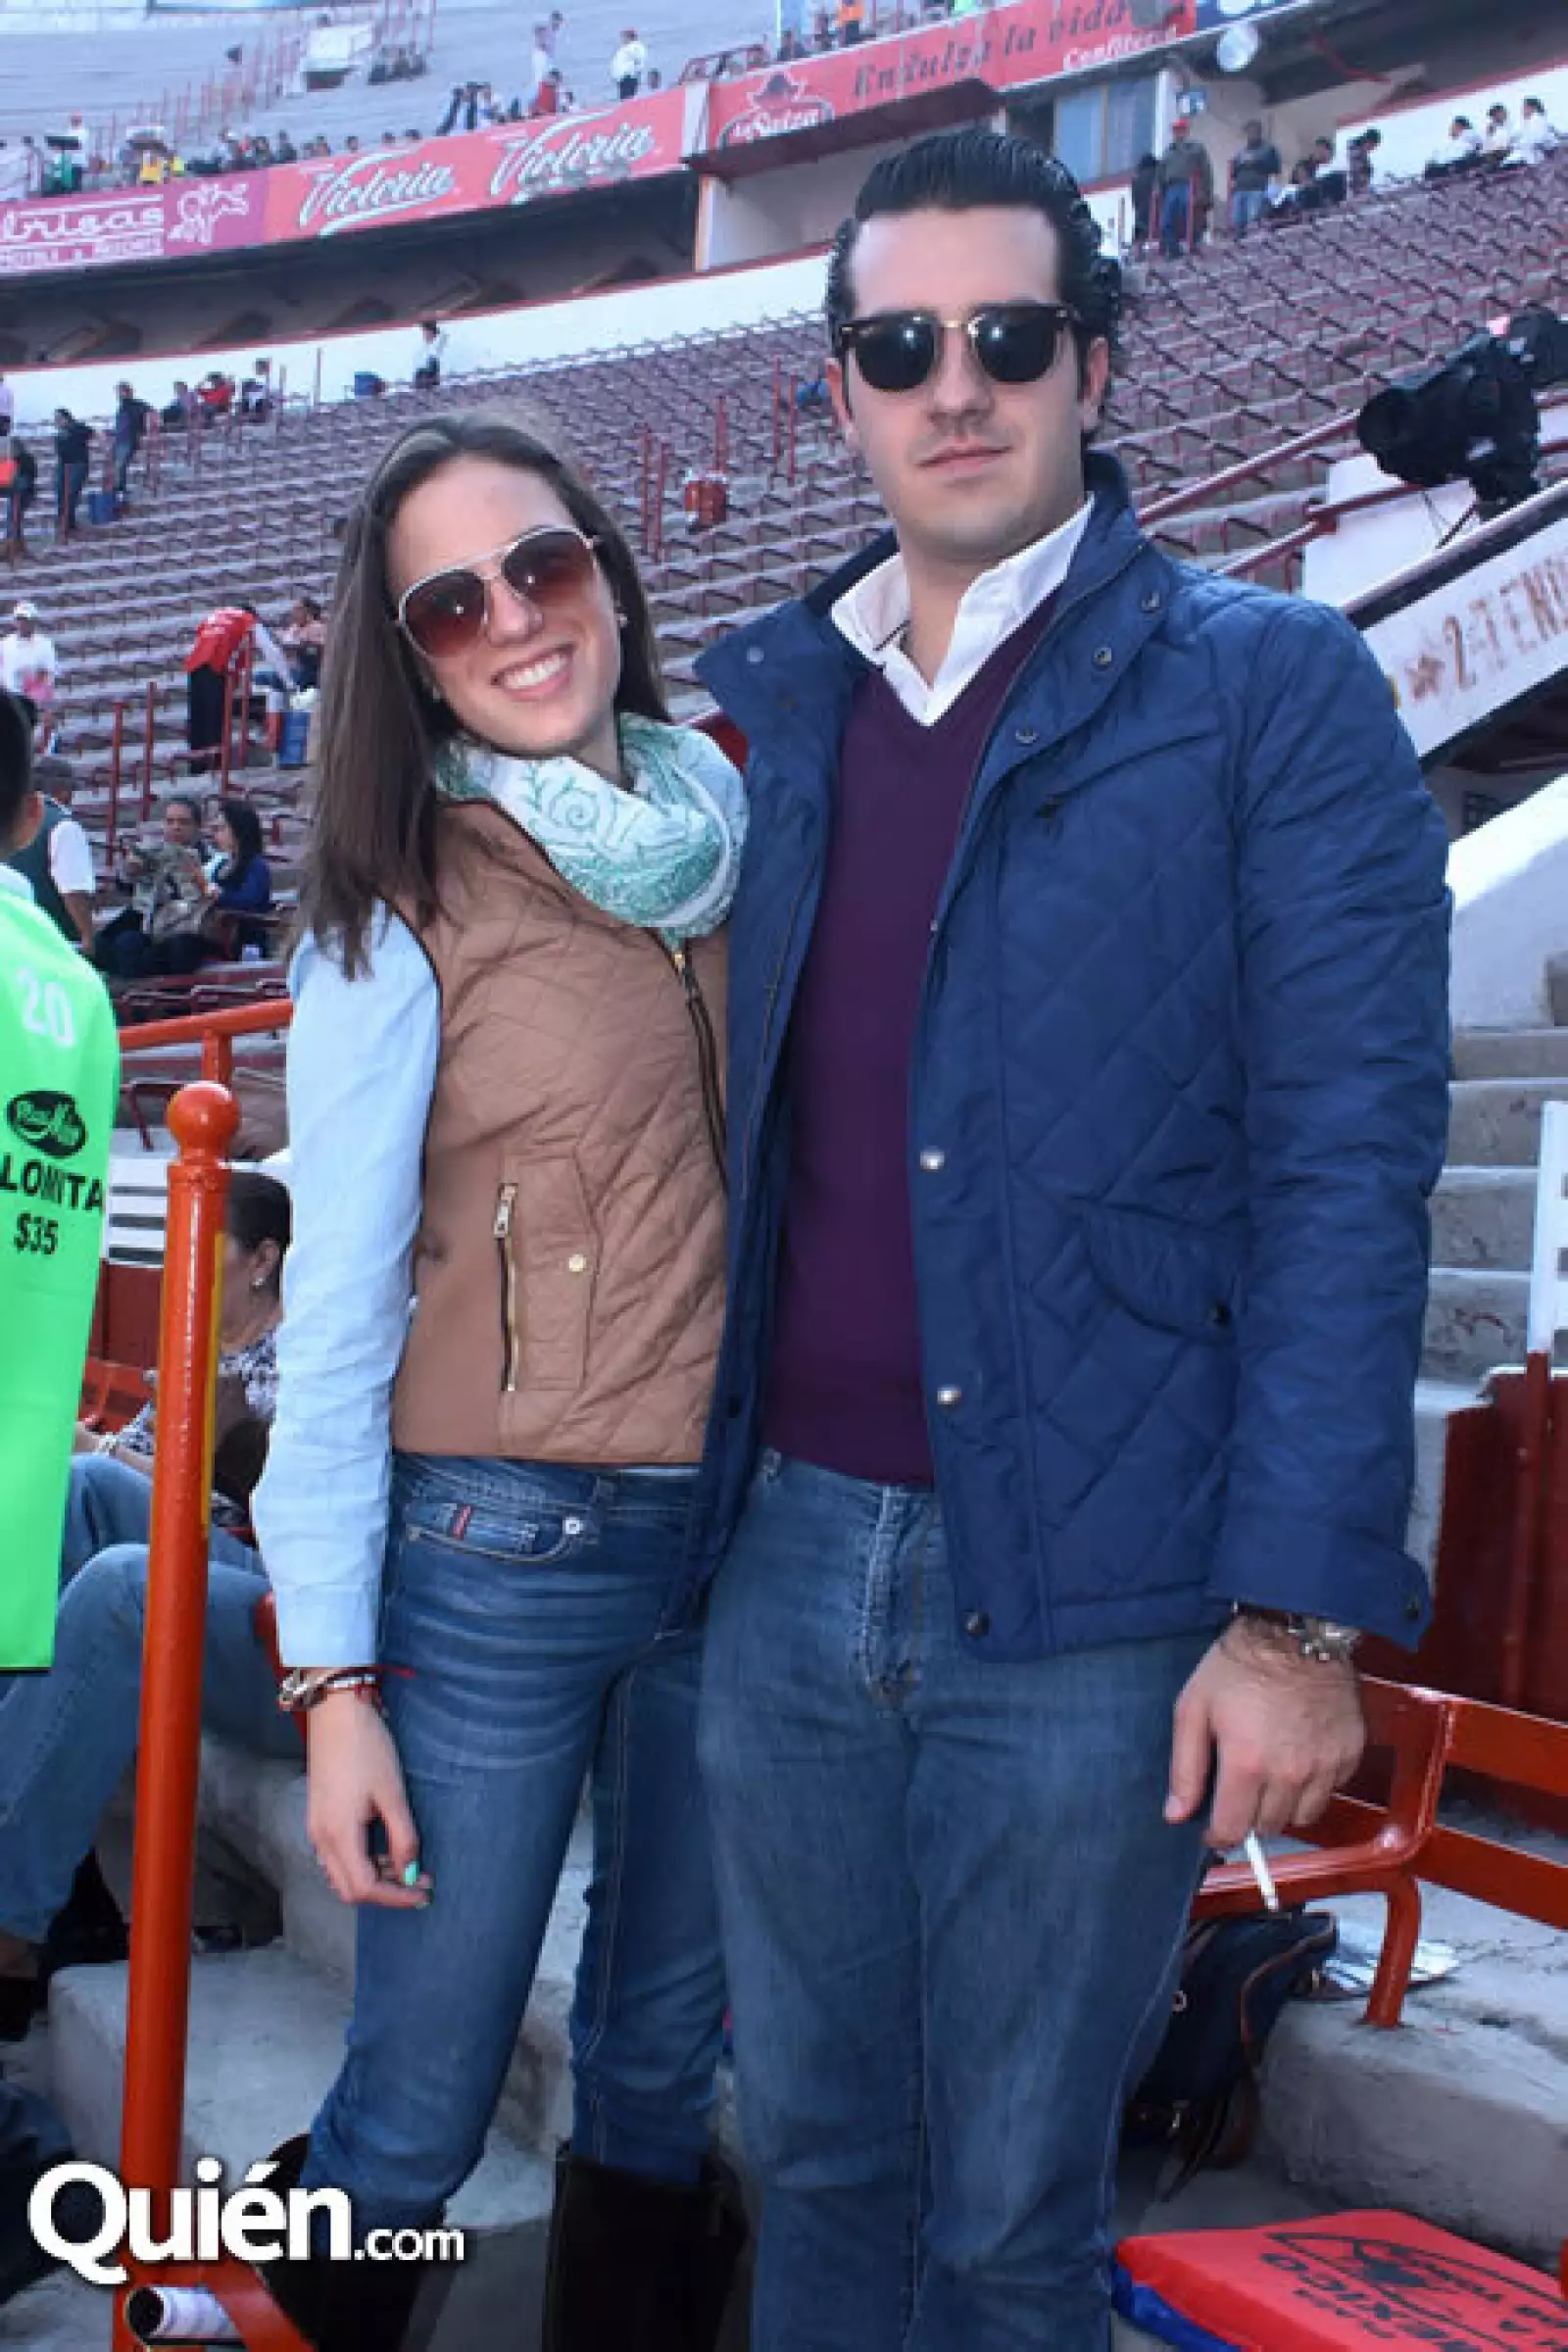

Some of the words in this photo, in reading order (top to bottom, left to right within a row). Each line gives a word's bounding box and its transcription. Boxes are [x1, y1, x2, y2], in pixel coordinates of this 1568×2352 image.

[1004, 24, 1037, 56] la
[297, 147, 456, 236] Victoria
[489, 106, 656, 205] Victoria
[14, 966, 74, 1049] 20
[14, 1212, 59, 1255] $35
